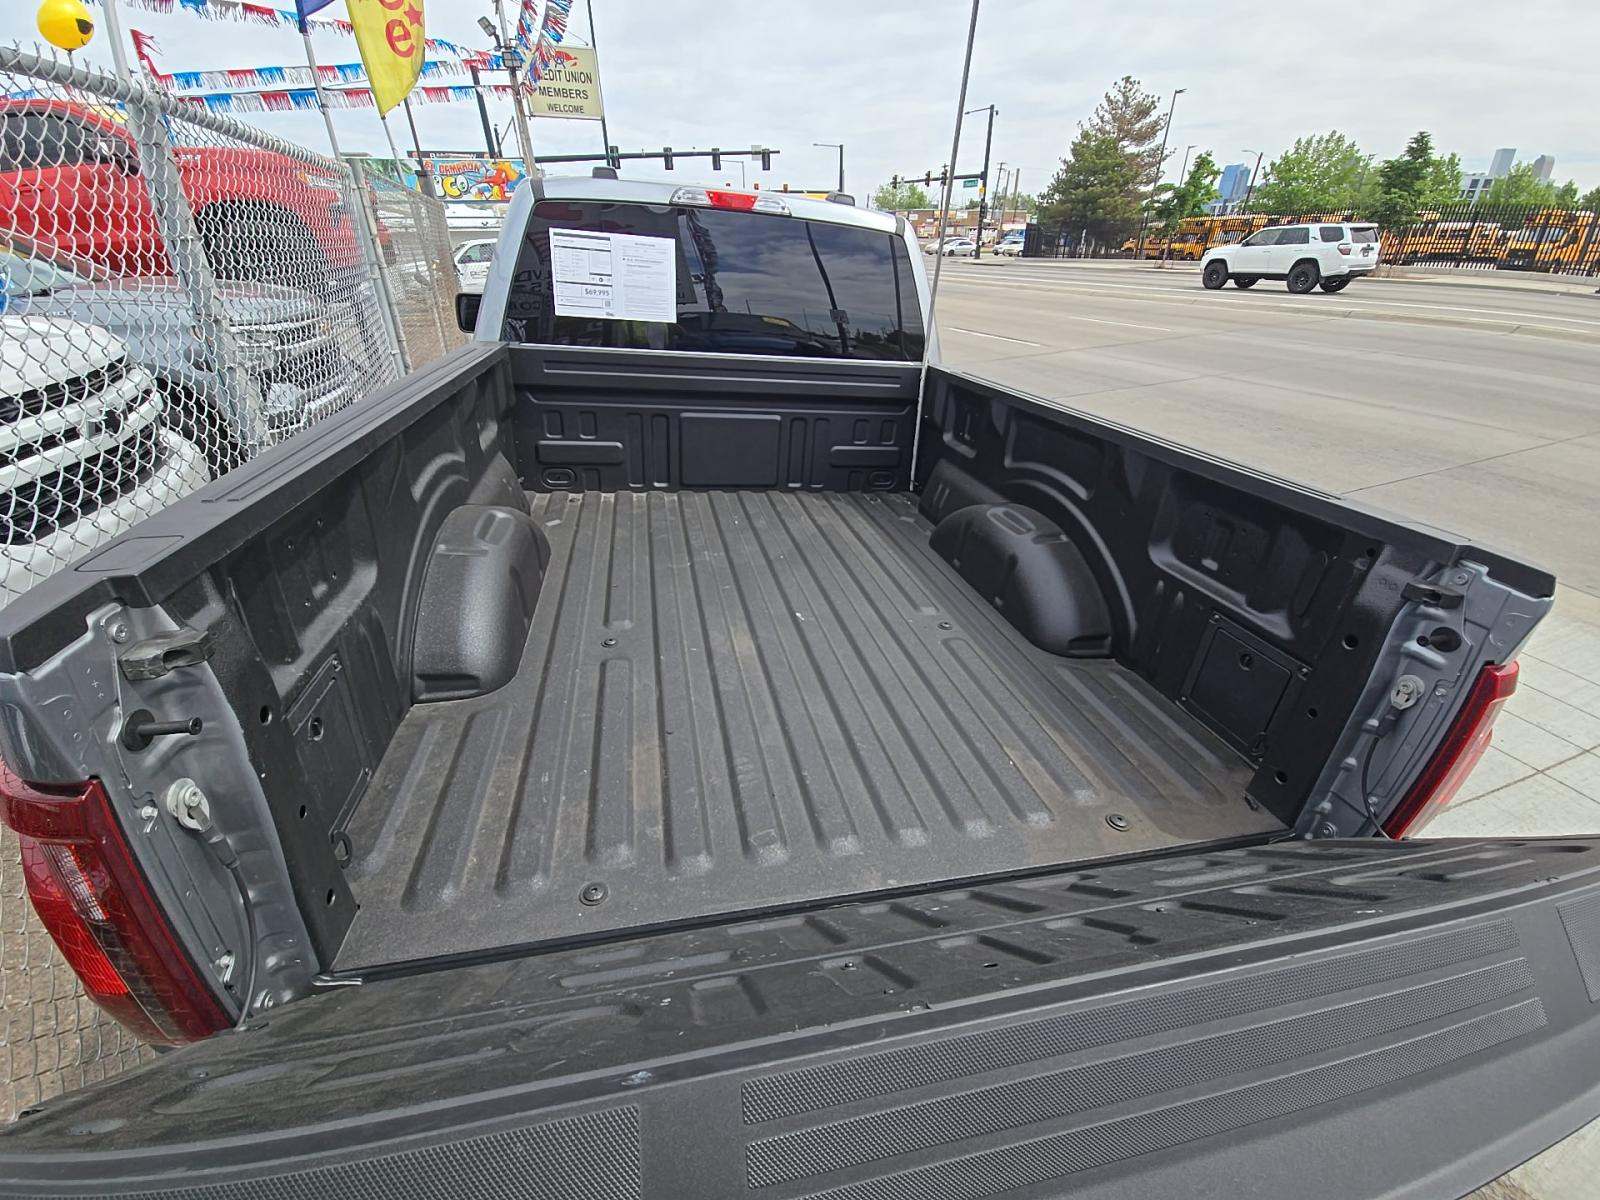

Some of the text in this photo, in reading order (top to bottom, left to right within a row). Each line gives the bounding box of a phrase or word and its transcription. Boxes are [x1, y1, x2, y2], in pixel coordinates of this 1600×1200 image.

[542, 68, 593, 85] EDIT UNION
[538, 86, 589, 100] MEMBERS
[547, 102, 585, 114] WELCOME
